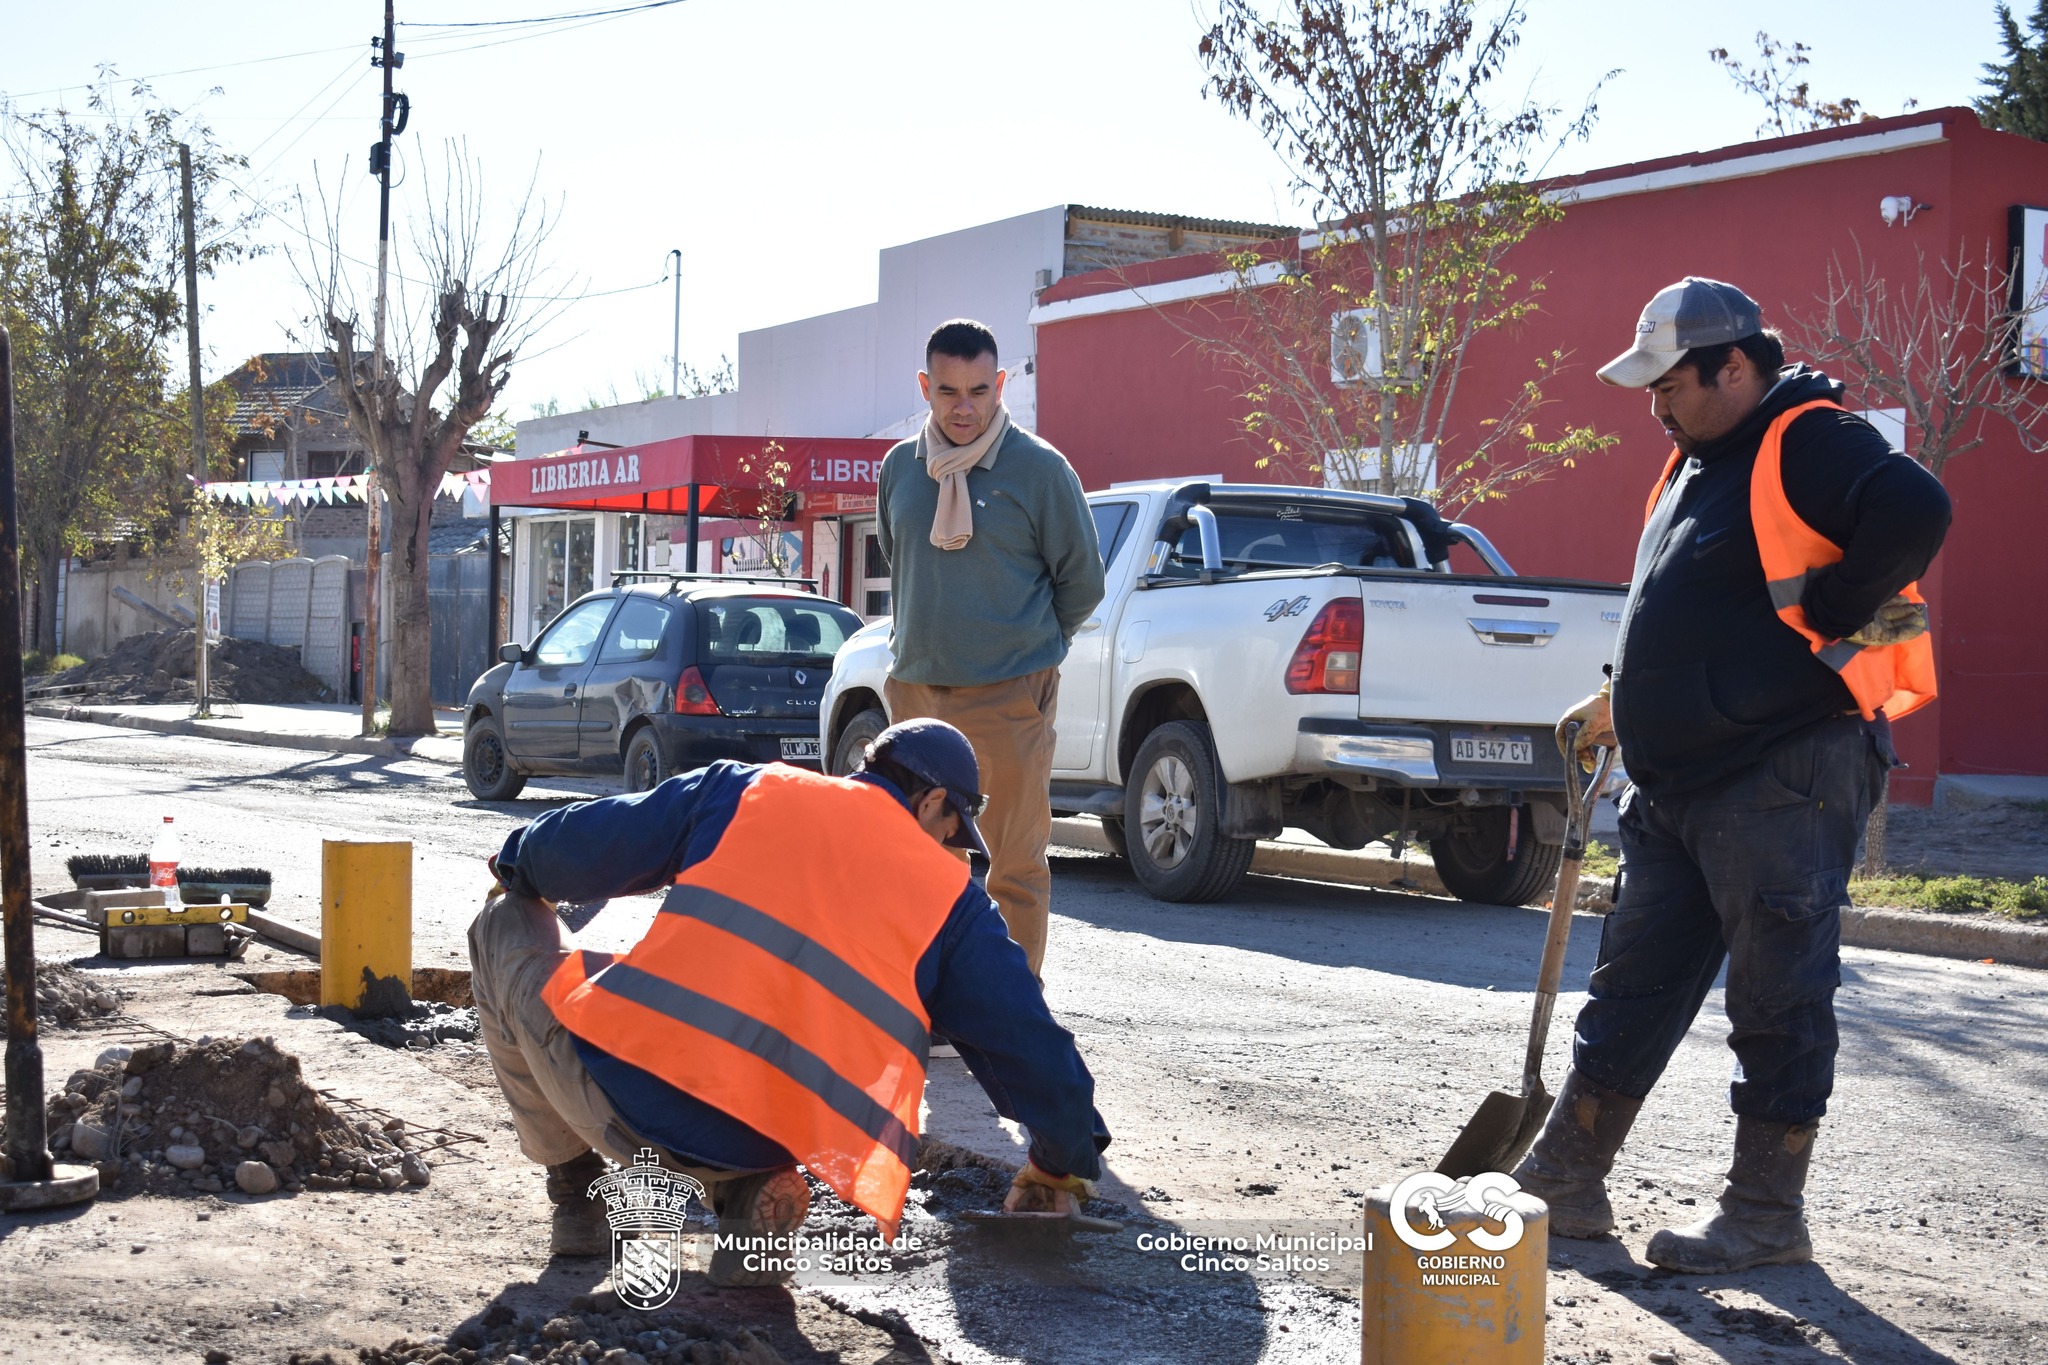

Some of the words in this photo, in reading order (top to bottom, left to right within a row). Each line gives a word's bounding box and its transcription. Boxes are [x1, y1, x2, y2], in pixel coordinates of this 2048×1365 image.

[531, 458, 610, 493] LIBRERIA
[613, 454, 640, 484] AR
[1369, 599, 1406, 610] TOYOTA
[1456, 740, 1474, 759] AD
[1479, 741, 1505, 760] 547
[1510, 742, 1529, 761] CY
